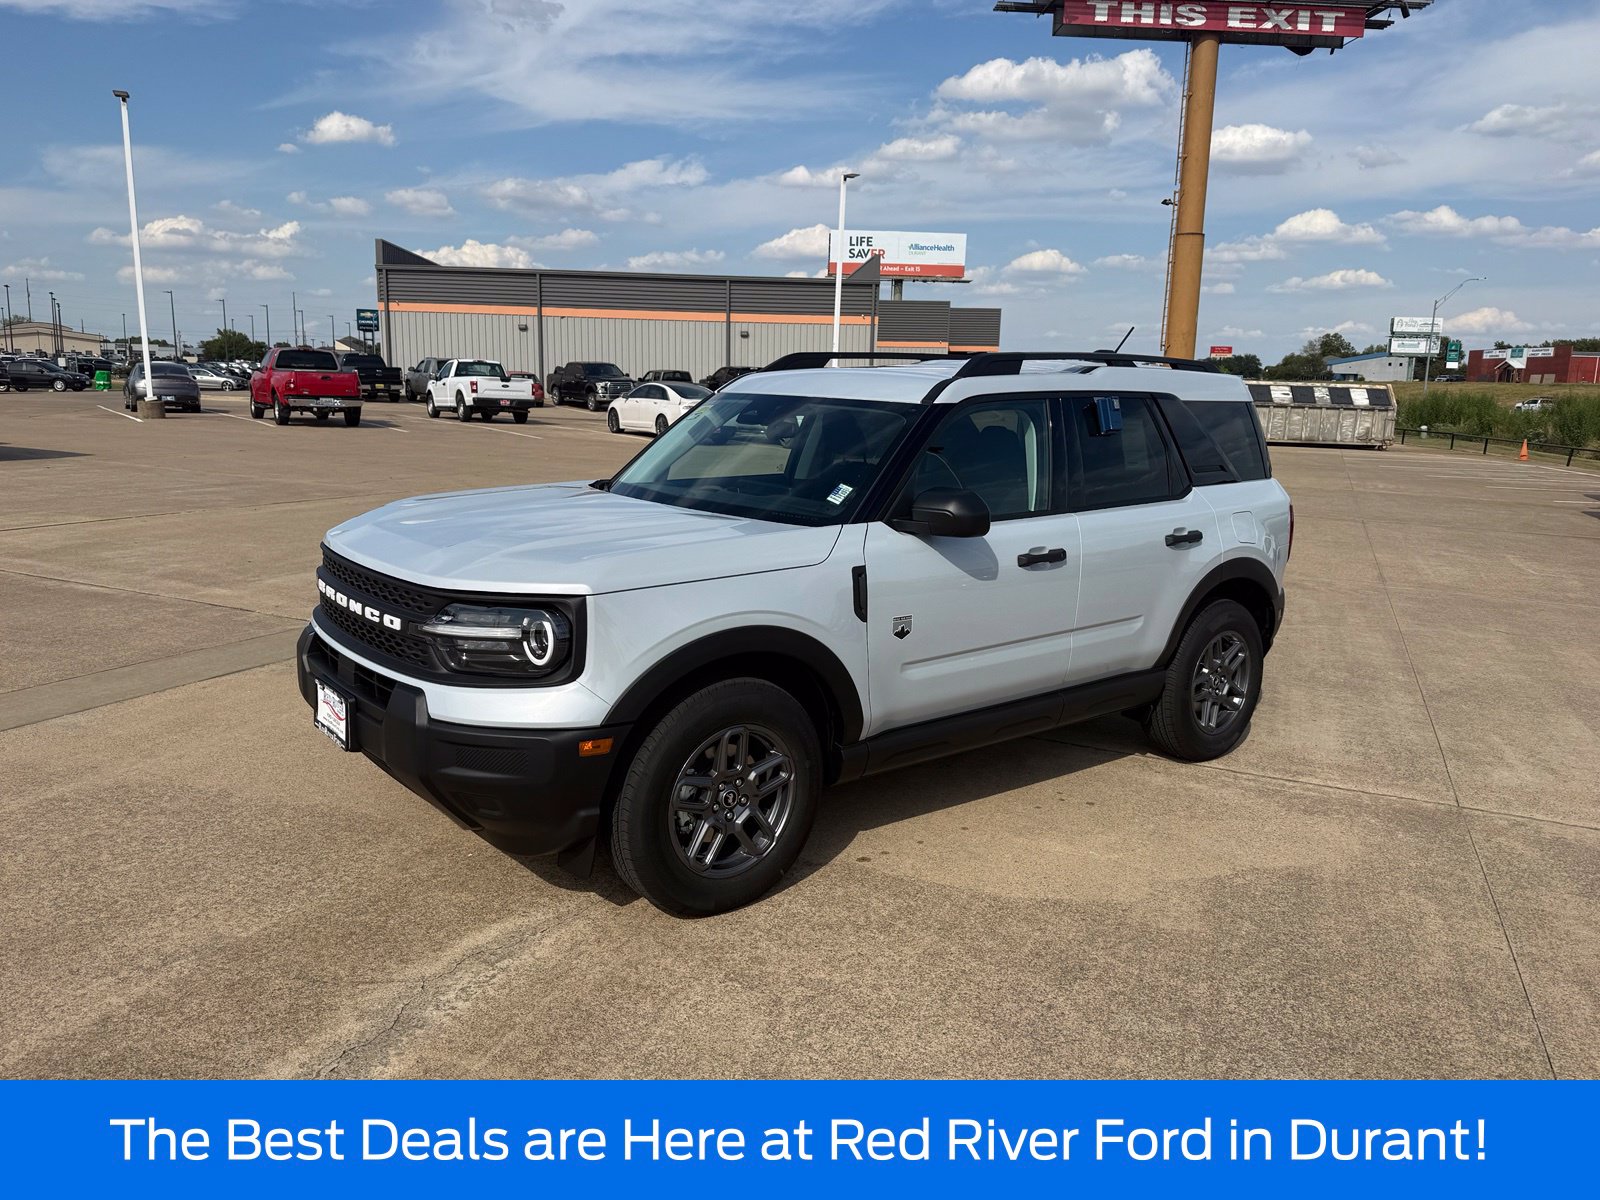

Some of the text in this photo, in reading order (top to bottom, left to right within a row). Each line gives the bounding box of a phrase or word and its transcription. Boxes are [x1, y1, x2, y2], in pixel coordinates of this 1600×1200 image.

[1087, 1, 1346, 32] THIS EXIT
[849, 236, 874, 247] LIFE
[909, 243, 955, 252] AllianceHealth
[848, 248, 886, 260] SAVER
[317, 578, 402, 631] BRONCO
